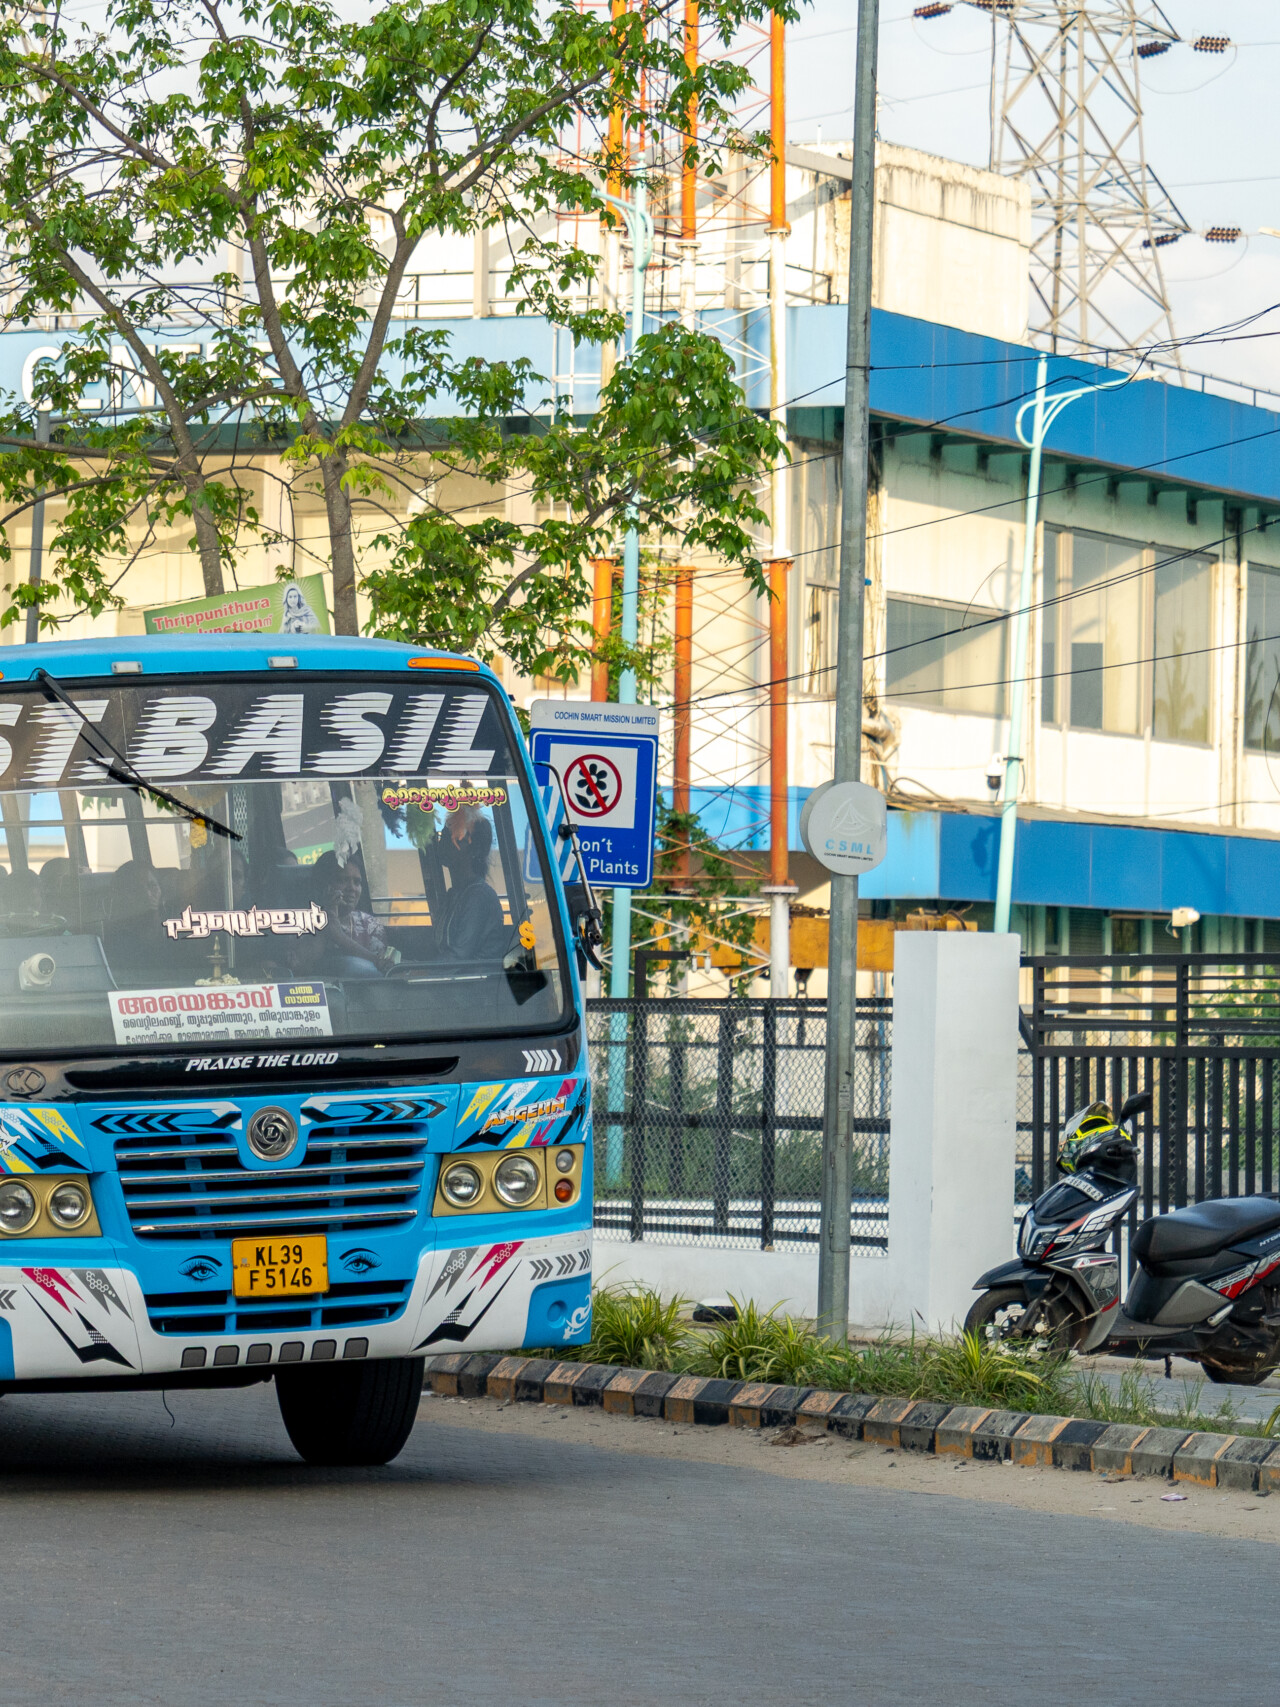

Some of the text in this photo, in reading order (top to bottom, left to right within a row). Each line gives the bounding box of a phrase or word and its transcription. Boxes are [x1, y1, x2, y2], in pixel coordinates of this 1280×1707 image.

[152, 597, 271, 632] Thrippunithura
[554, 711, 657, 726] COCHIN SMART MISSION LIMITED
[576, 838, 613, 853] on't
[590, 858, 639, 875] Plants
[117, 985, 275, 1015] അരയങ്കാവ്
[185, 1052, 339, 1073] PRAISE THE LORD
[255, 1244, 303, 1267] KL39
